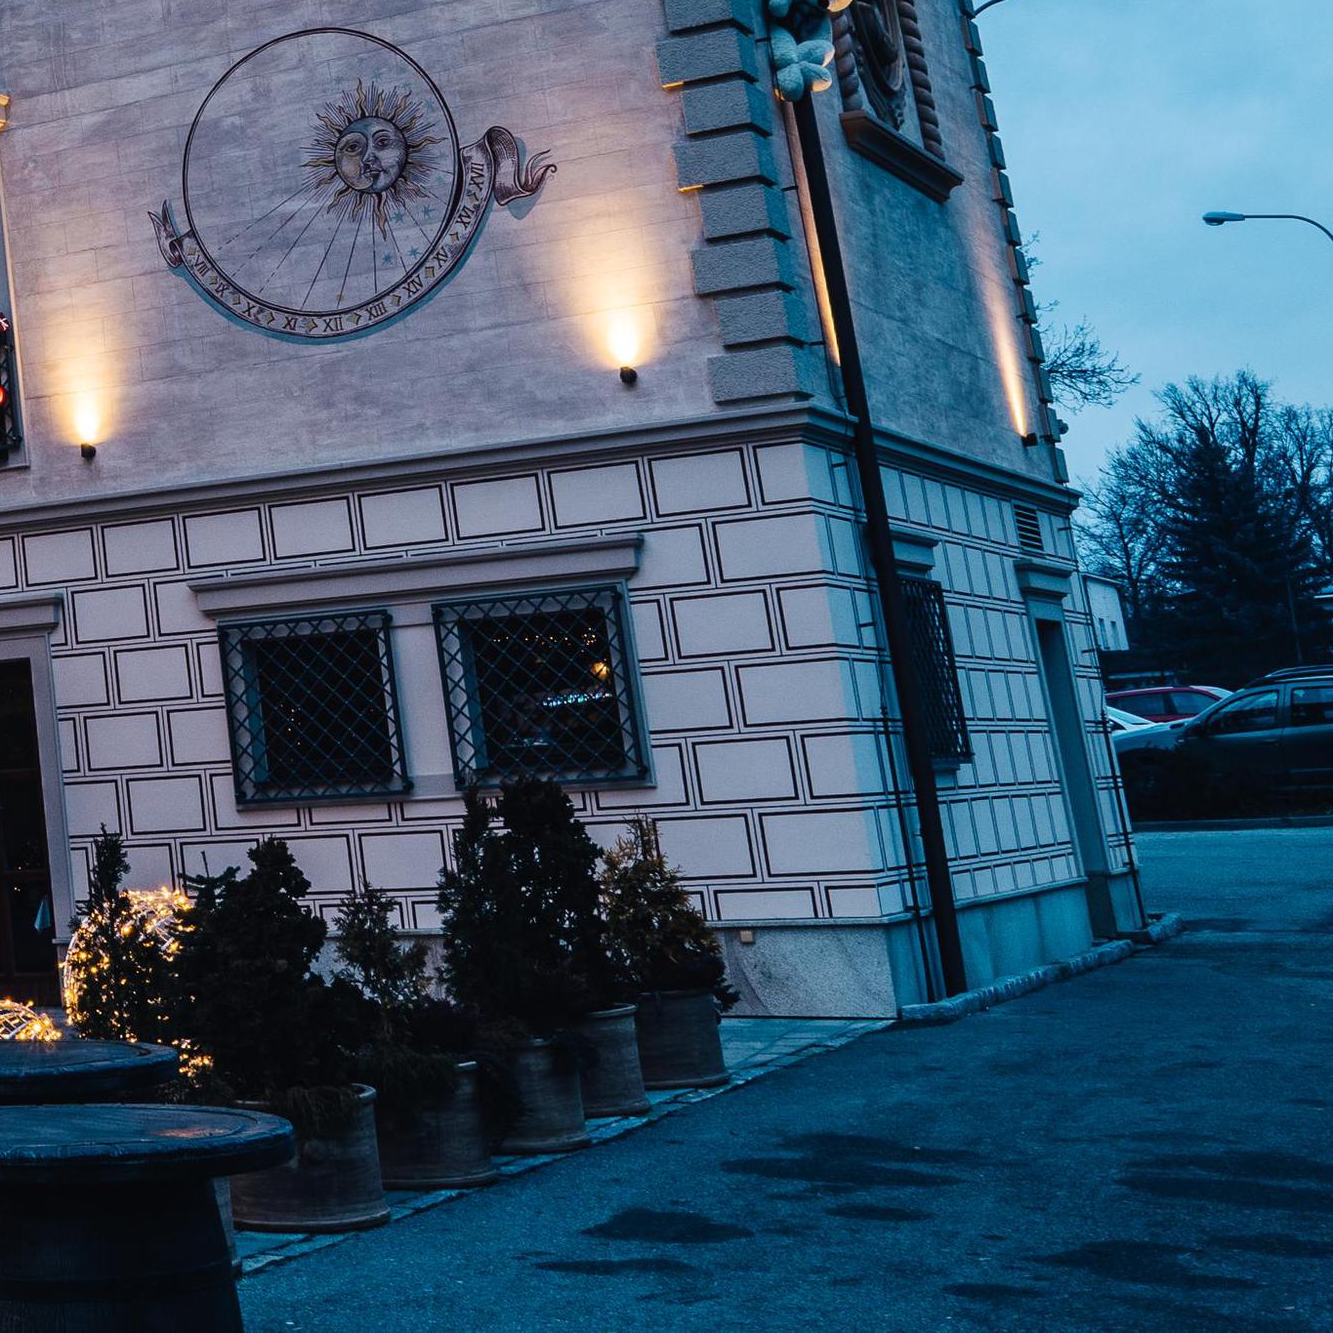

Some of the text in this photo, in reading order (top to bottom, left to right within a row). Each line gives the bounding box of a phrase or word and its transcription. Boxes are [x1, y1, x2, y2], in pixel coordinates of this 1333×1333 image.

[193, 162, 485, 333] VIII IX X XI XII XIII XIV XV XVI XVII
